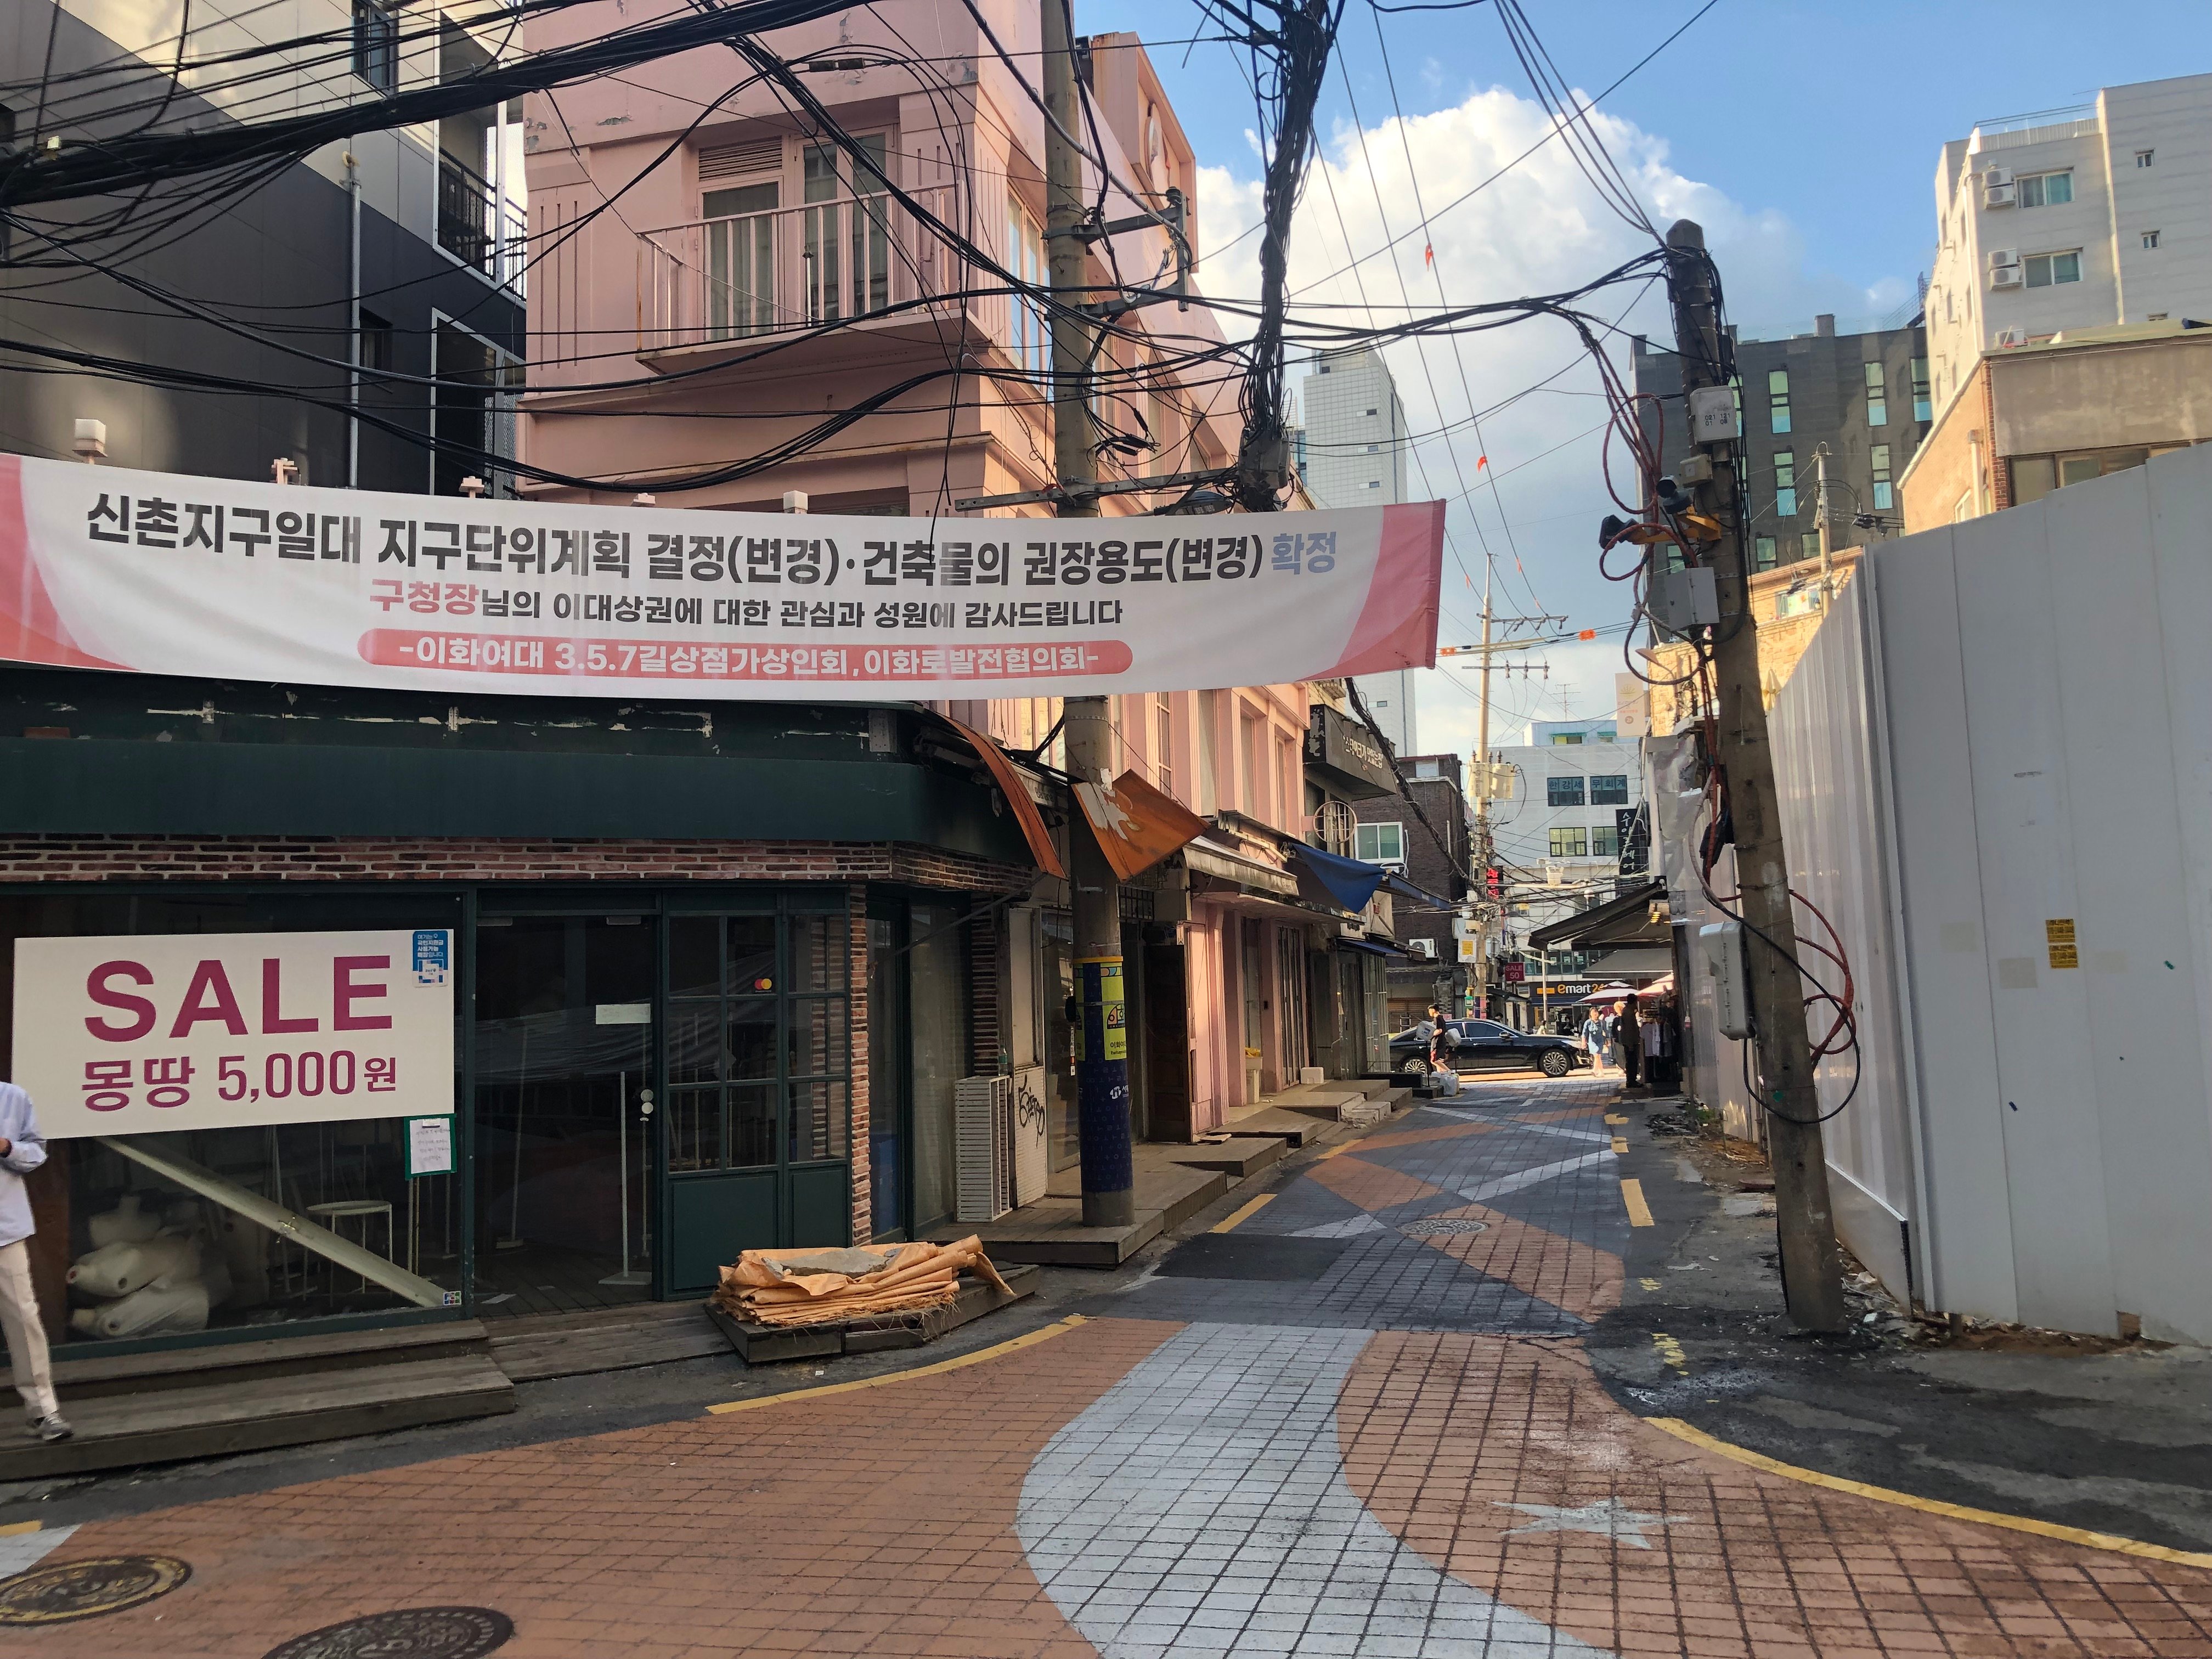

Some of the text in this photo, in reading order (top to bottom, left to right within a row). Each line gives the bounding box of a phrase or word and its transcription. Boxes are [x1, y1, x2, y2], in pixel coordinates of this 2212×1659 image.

[88, 493, 362, 564] 신촌지구일대
[379, 518, 630, 579] 지구단위계획
[1024, 534, 1263, 585] 권장용도(변경)
[1271, 532, 1337, 575] 확정
[370, 579, 1123, 629] 구청장님의 이대상권에 대한 관심과 성원에 감사드립니다
[84, 955, 393, 1042] SALE
[82, 1050, 397, 1113] 몽땅 5,000원
